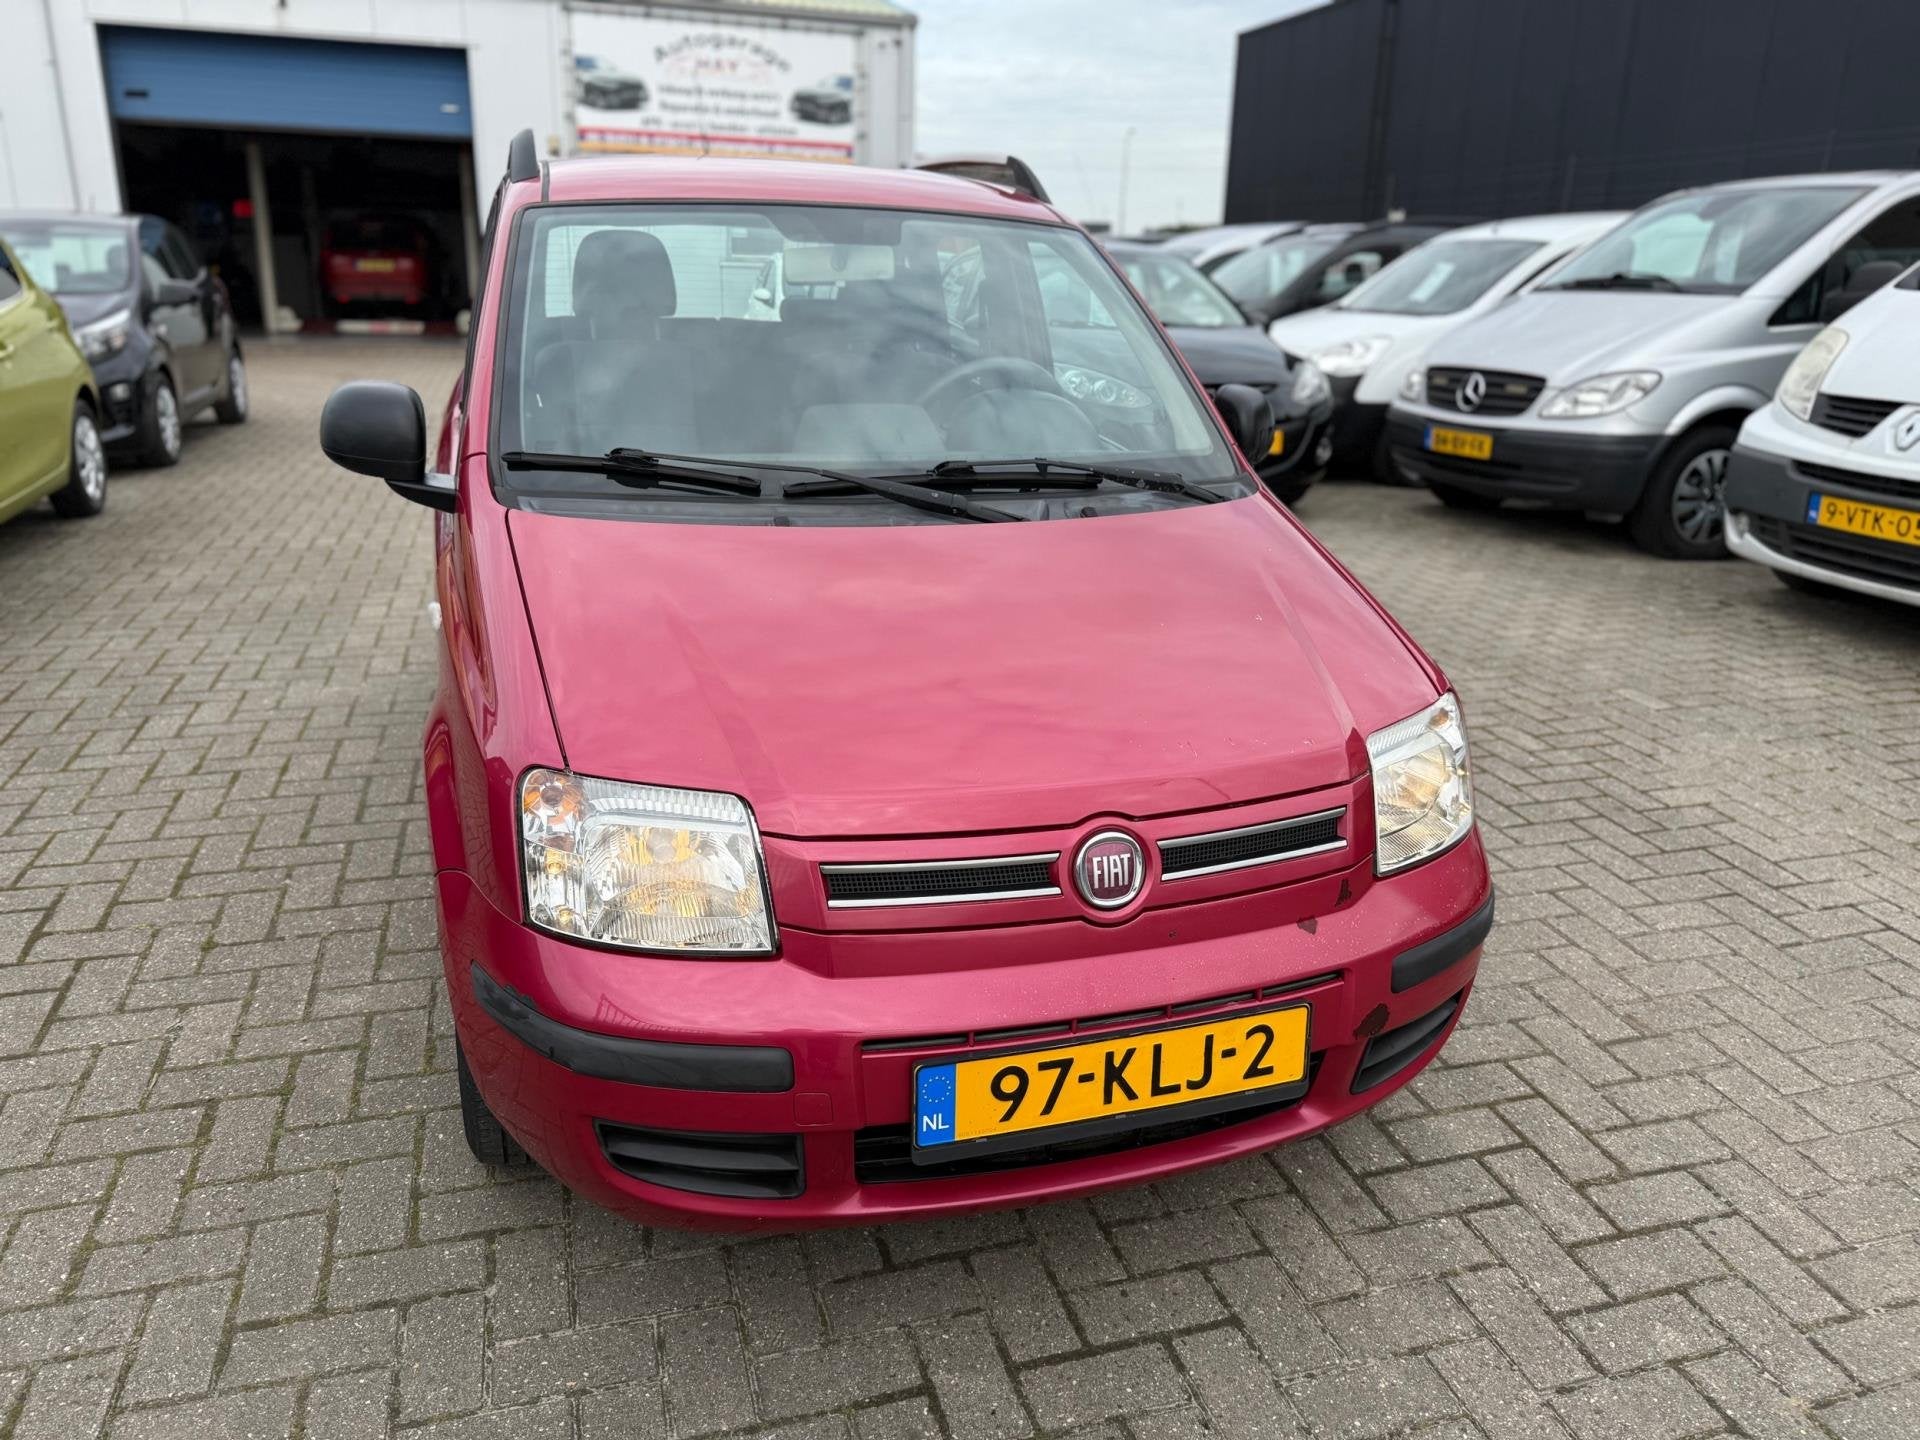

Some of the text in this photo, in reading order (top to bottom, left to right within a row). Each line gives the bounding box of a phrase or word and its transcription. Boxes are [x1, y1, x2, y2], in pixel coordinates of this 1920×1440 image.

[1092, 853, 1131, 889] FIAT
[990, 1023, 1275, 1123] 97-KLJ-2
[922, 1113, 950, 1132] NL
